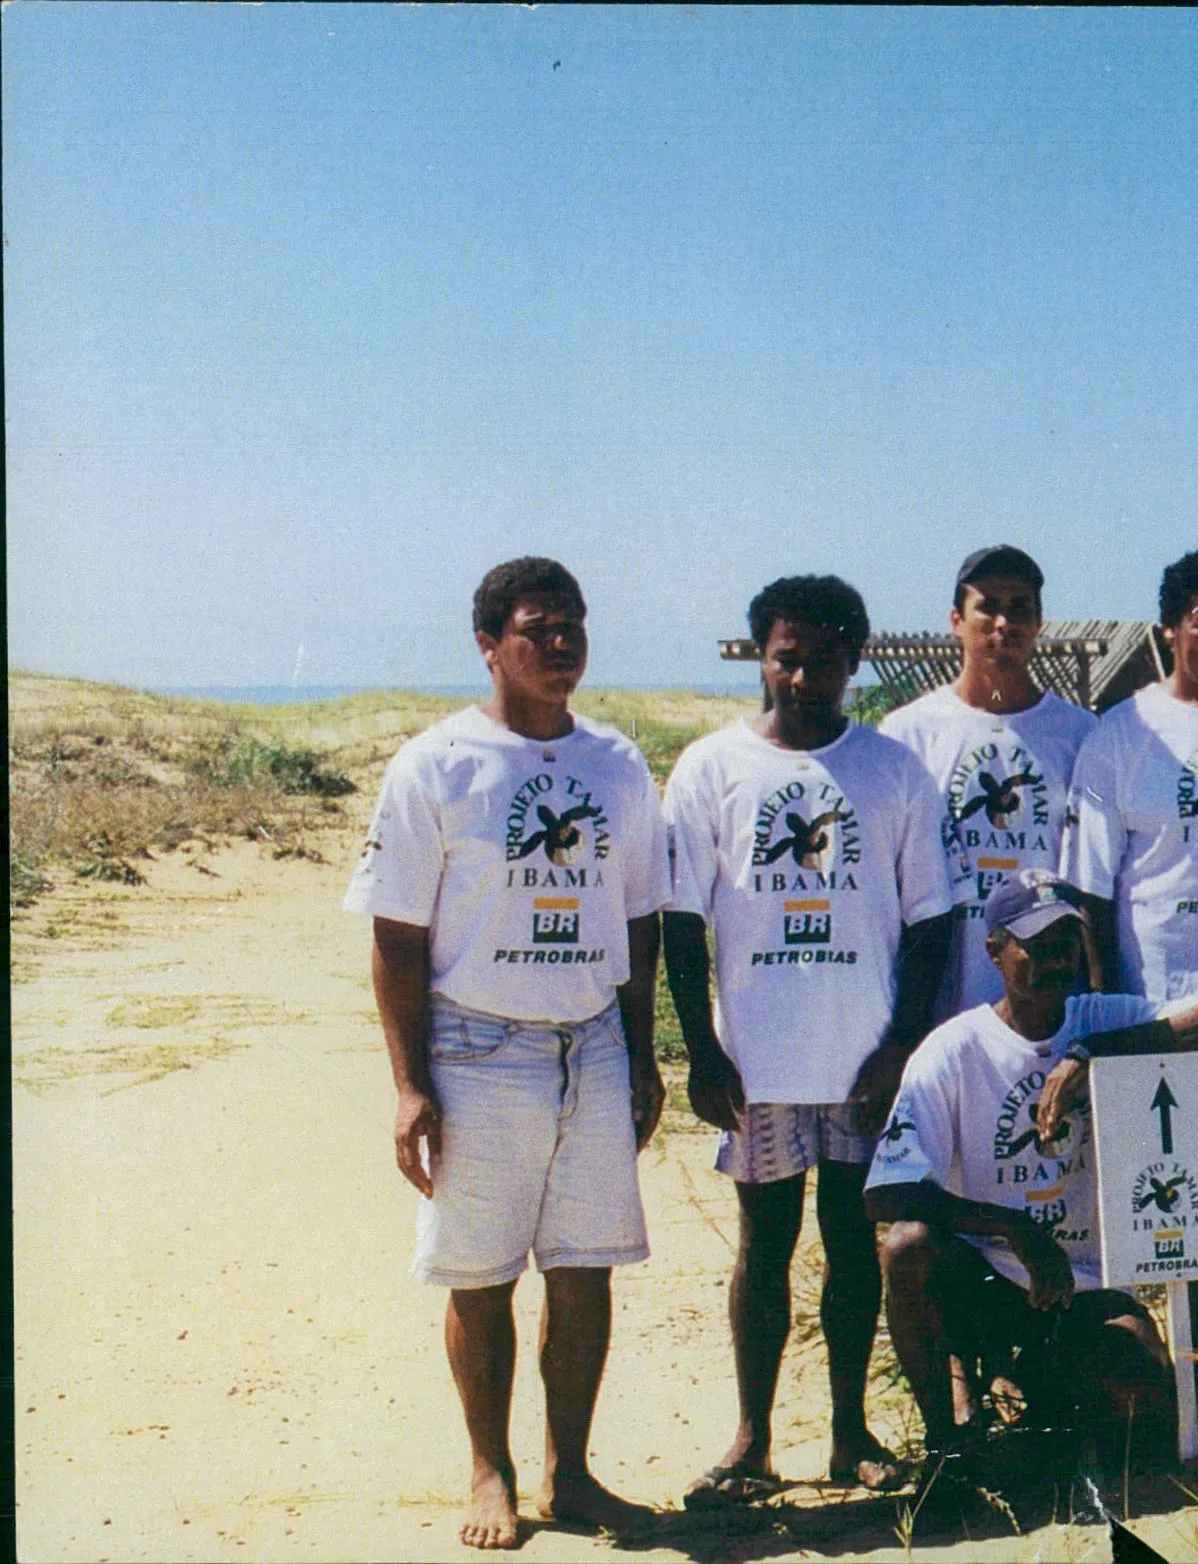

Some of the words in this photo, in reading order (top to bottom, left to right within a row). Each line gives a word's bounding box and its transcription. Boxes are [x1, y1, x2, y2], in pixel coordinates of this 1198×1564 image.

[505, 773, 553, 862] PROJETO
[753, 781, 805, 867] PROJETO
[506, 868, 604, 888] IBAMA
[754, 871, 858, 892] IBAMA
[534, 913, 579, 936] BR
[786, 914, 830, 937] BR
[494, 950, 605, 964] PETROBRAS
[751, 951, 857, 966] PETROBRAS
[995, 1070, 1046, 1160] PROJETO
